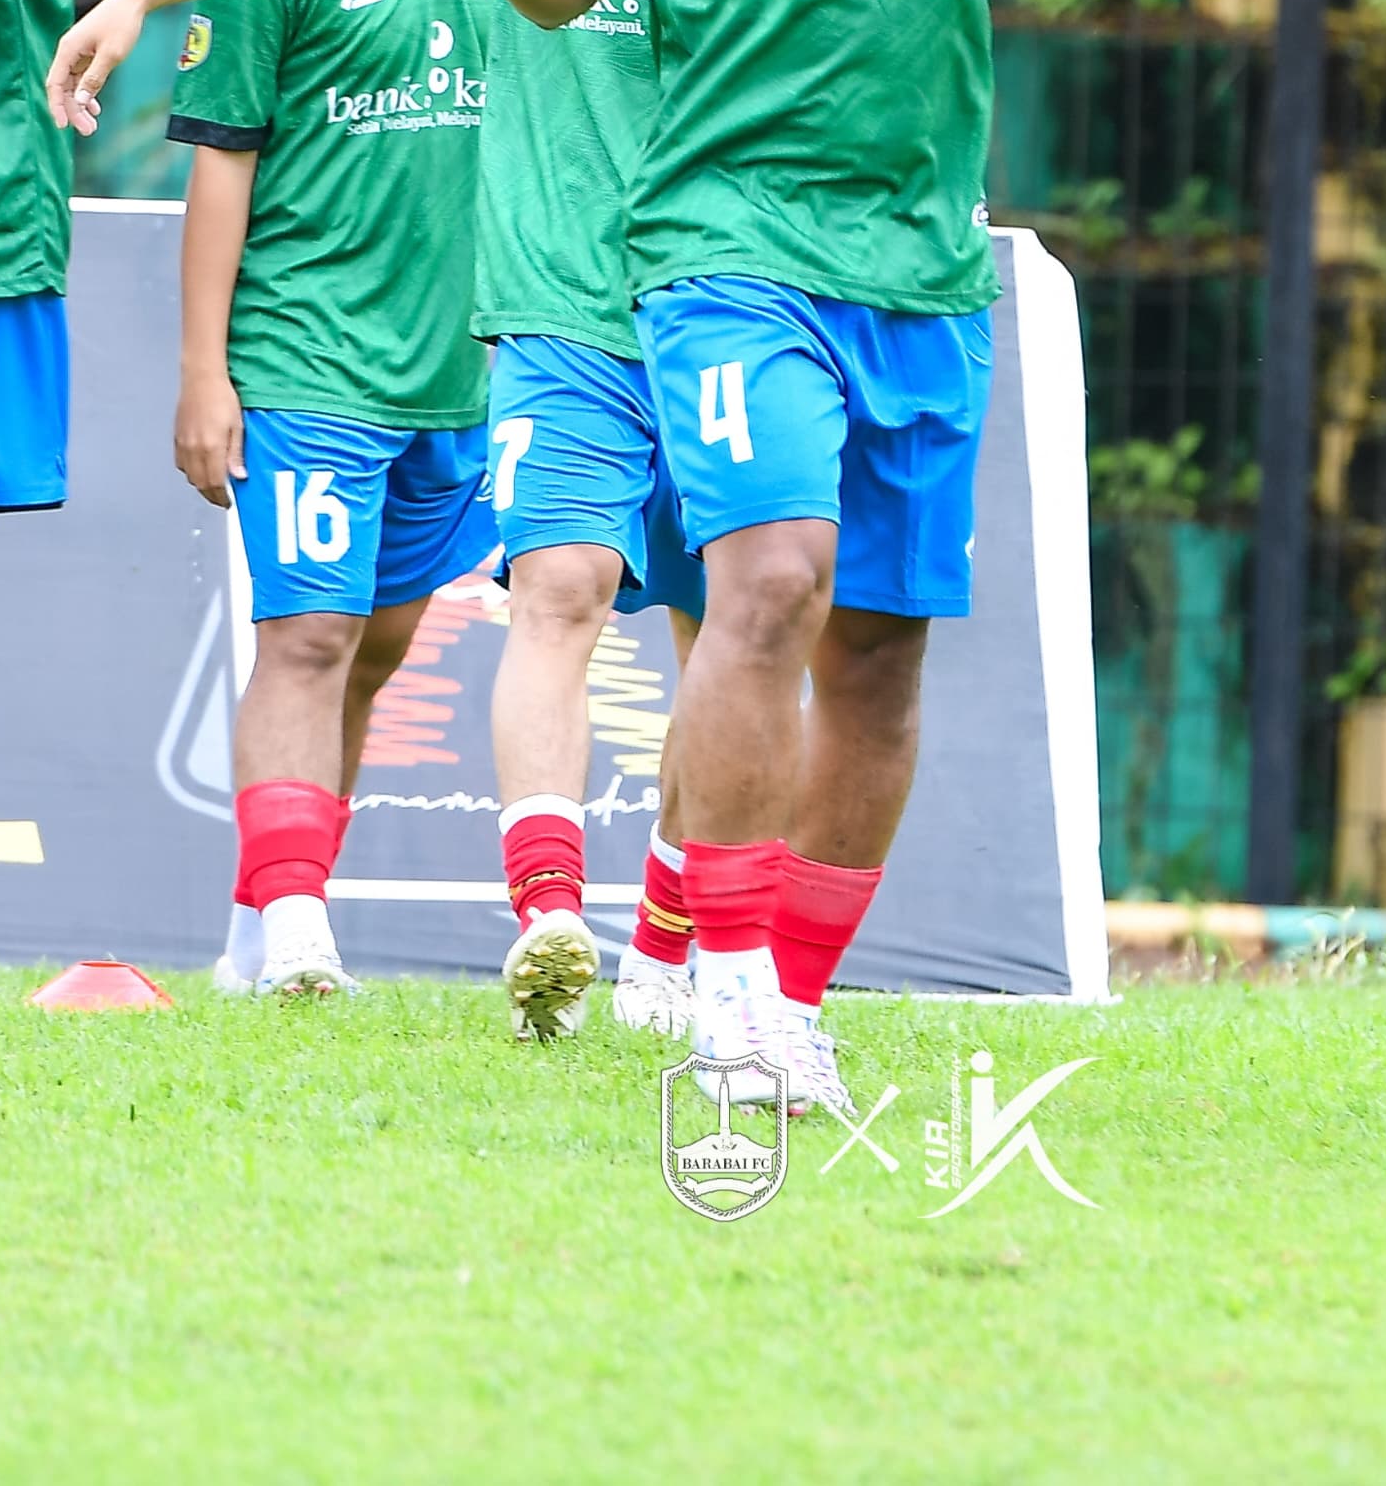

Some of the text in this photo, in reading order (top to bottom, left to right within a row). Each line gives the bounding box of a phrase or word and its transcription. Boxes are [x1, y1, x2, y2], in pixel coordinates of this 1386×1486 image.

[698, 360, 755, 464] 4
[492, 416, 534, 512] 7
[274, 470, 351, 565] 16
